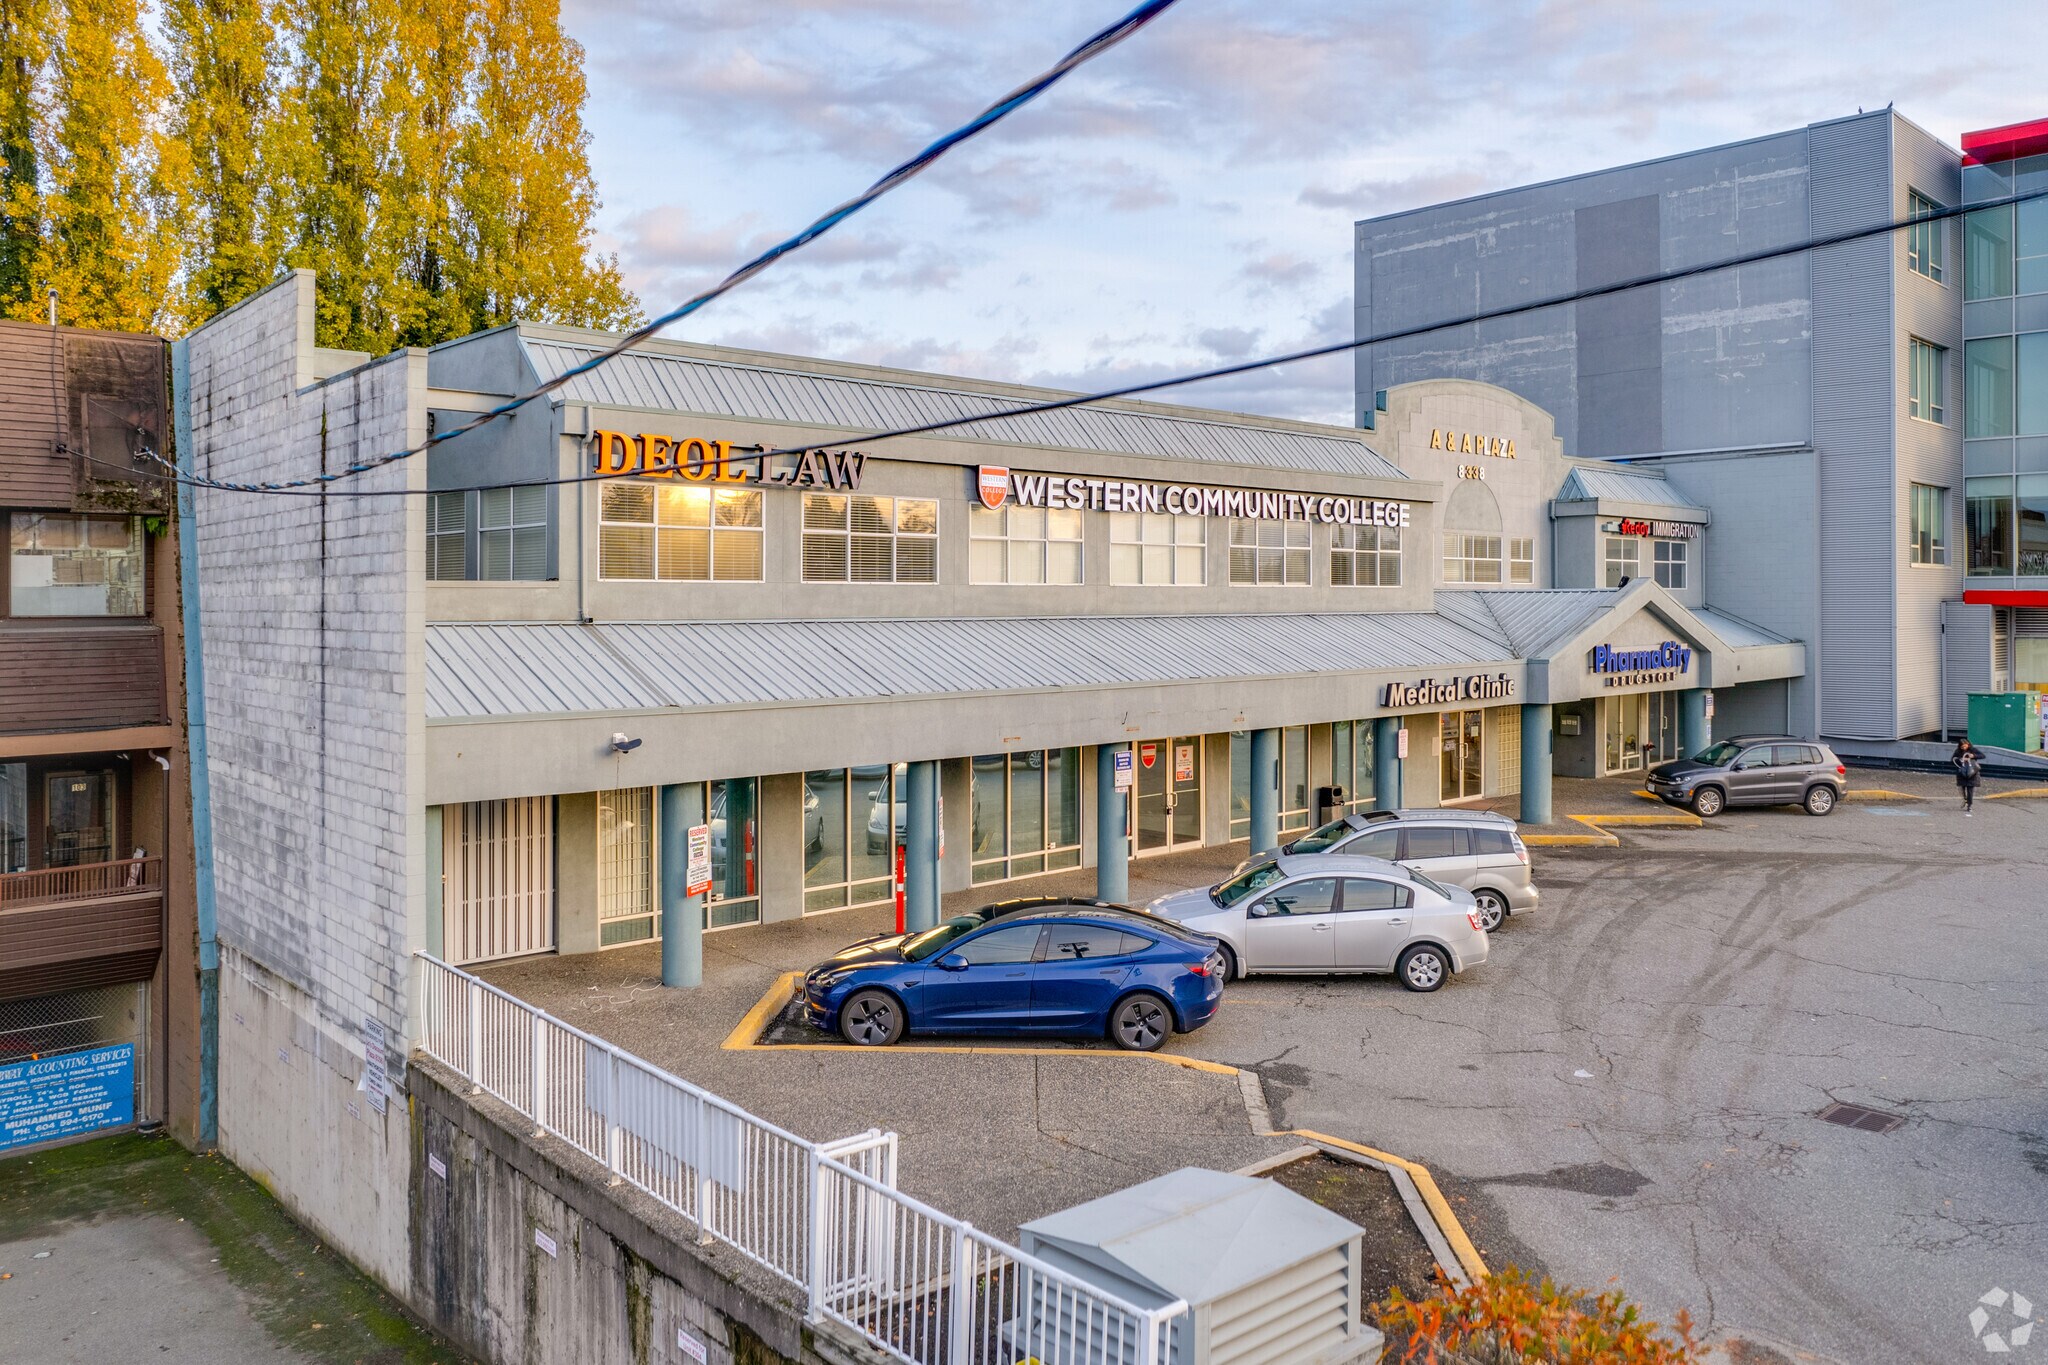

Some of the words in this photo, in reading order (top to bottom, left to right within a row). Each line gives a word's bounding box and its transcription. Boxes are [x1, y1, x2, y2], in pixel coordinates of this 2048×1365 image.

[1430, 429, 1441, 450] A
[1446, 431, 1456, 452] &
[1461, 433, 1472, 453] A
[1475, 435, 1517, 459] PLAZA
[593, 429, 747, 483] DEOL
[755, 443, 871, 490] LAW
[1458, 464, 1485, 480] 8338
[1011, 474, 1158, 513] WESTERN
[1163, 485, 1315, 520] COMMUNITY
[1317, 497, 1410, 527] COLLEGE
[1652, 521, 1699, 538] IMMIGRATION
[1593, 641, 1691, 673] PharmaCity
[1385, 677, 1462, 707] Medical
[1465, 673, 1515, 699] Clinic
[27, 1056, 88, 1077] ACCOUNTING
[91, 1047, 131, 1064] SERVICES
[72, 1091, 108, 1102] REBATES
[5, 1110, 73, 1130] MUHAMMED
[78, 1102, 113, 1115] MUNIF
[13, 1128, 31, 1136] PH:
[35, 1122, 55, 1132] 604
[60, 1112, 104, 1127] 594-6170
